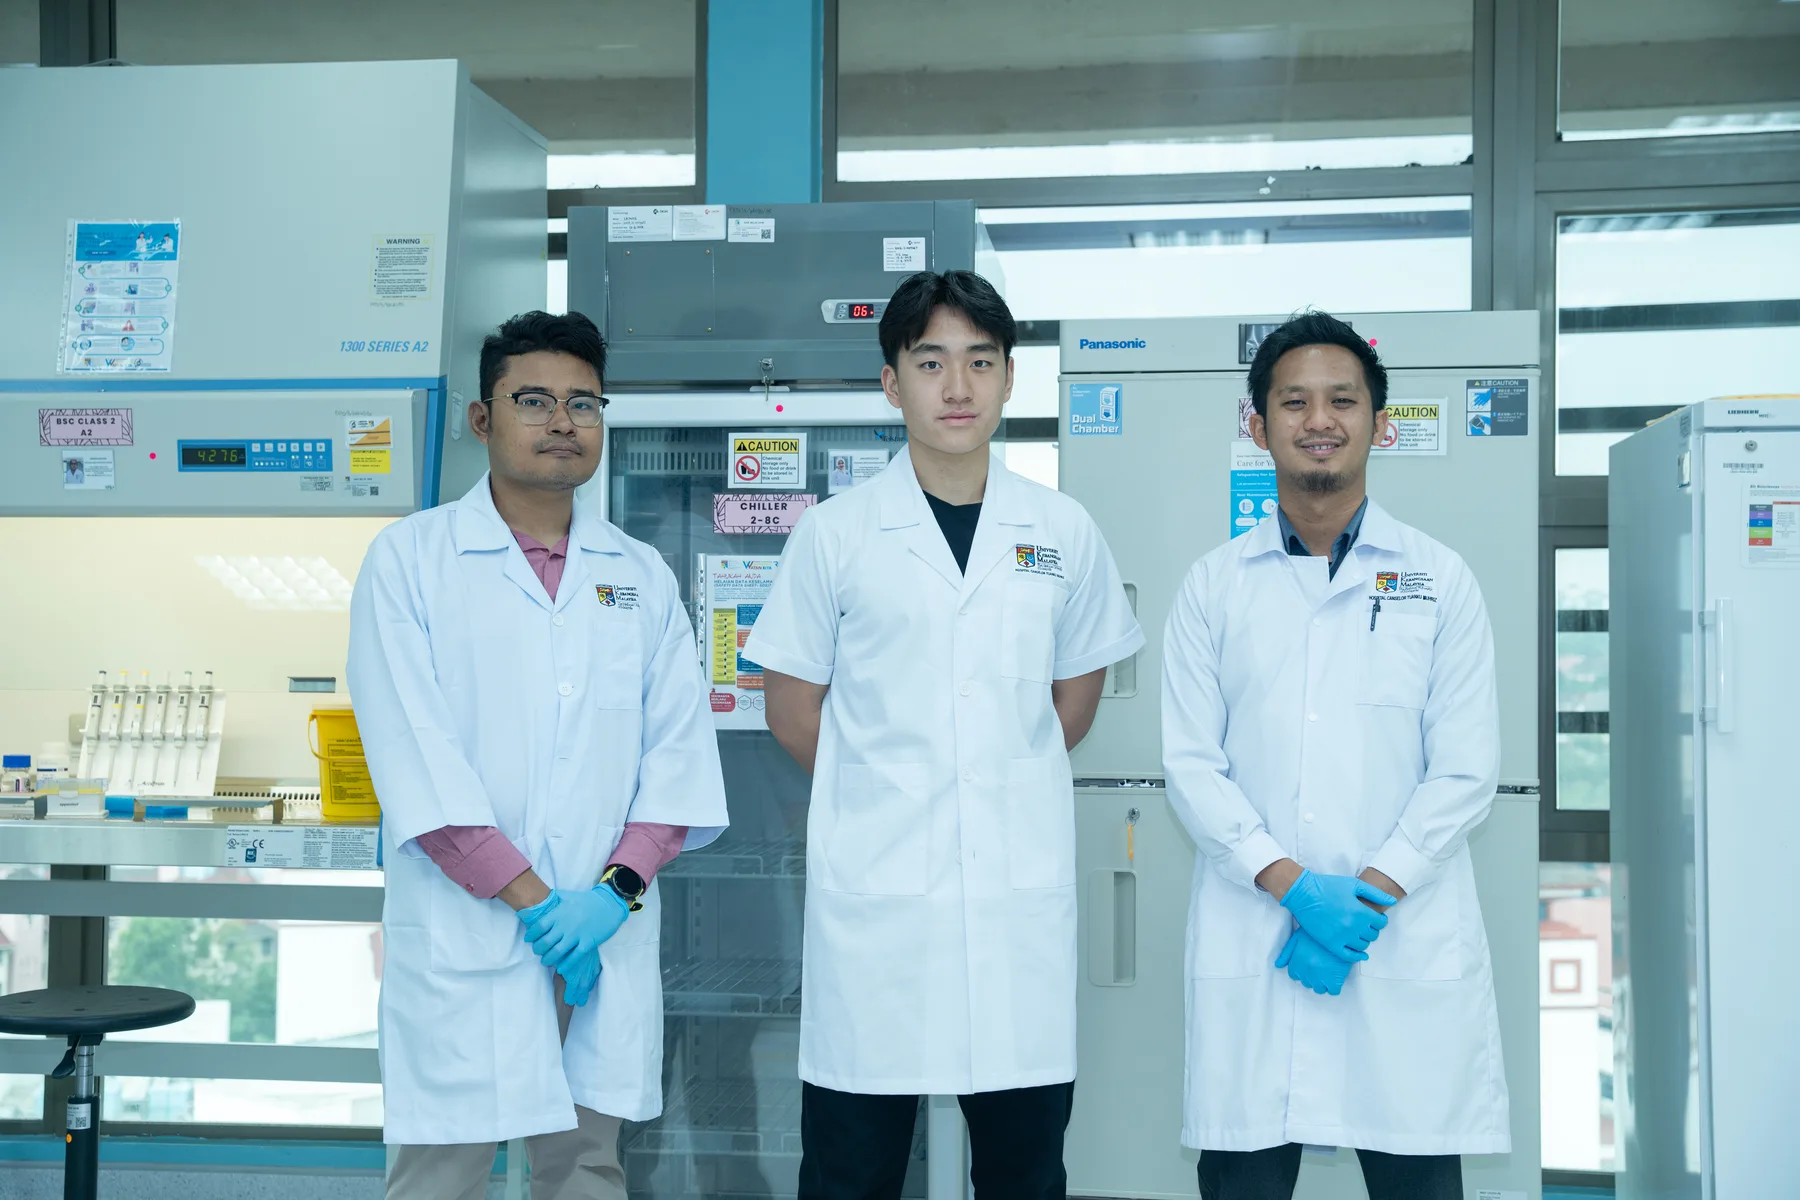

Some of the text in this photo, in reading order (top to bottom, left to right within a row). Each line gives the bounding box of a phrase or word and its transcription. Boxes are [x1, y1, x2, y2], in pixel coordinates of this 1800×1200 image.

[853, 305, 868, 317] 06
[340, 340, 429, 352] 1300 SERIES A2
[1080, 338, 1146, 350] Panasonic
[1072, 414, 1096, 424] Dual
[80, 429, 93, 437] A2
[1072, 424, 1120, 434] Chamber
[748, 441, 798, 452] CAUTION
[198, 450, 238, 462] 4276
